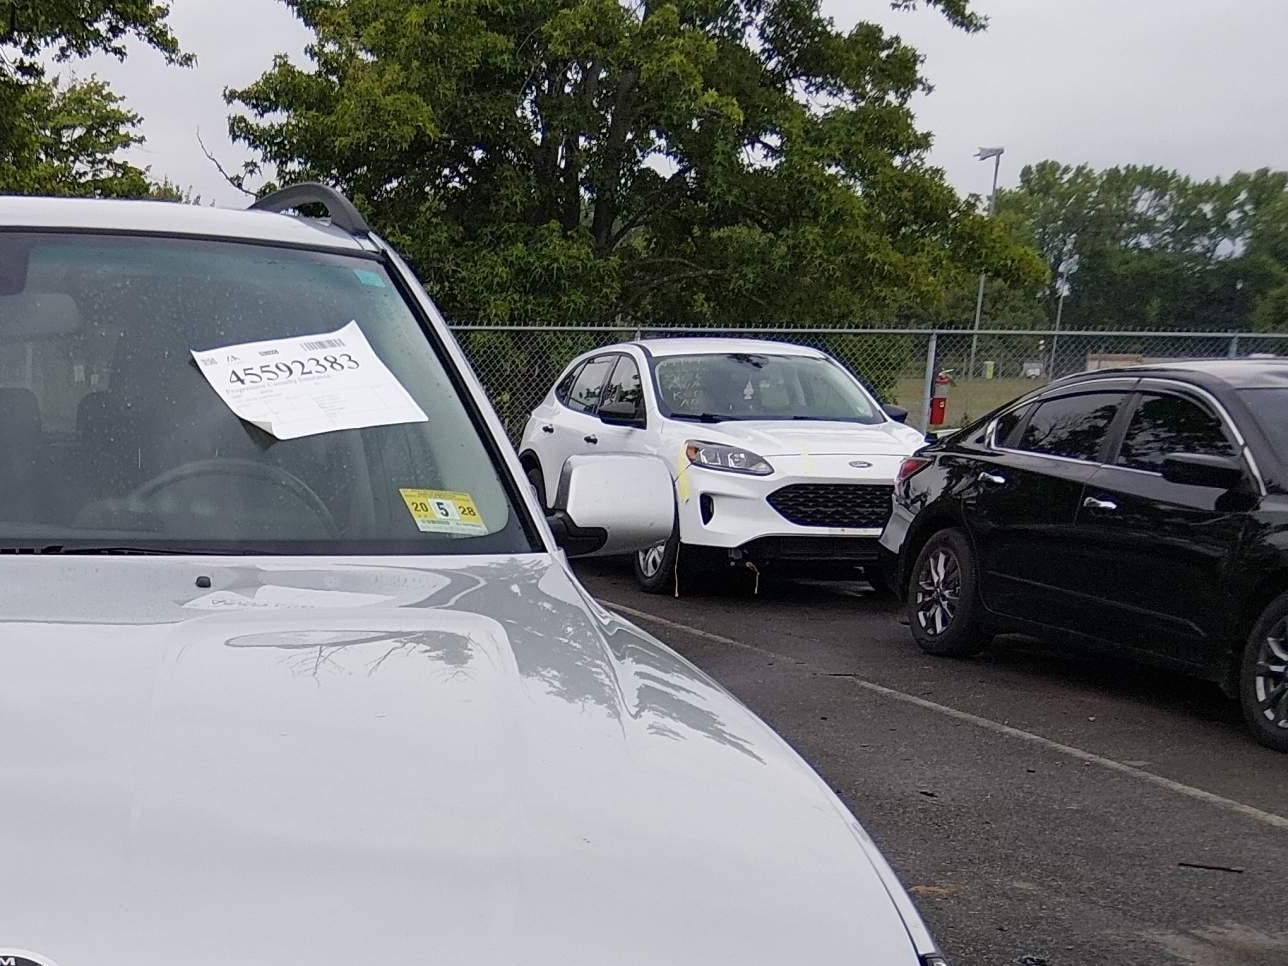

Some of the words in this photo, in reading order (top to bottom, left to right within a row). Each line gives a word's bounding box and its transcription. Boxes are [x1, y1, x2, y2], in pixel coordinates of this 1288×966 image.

[229, 353, 360, 386] 45592383
[411, 502, 429, 513] 20
[435, 501, 450, 518] 5
[458, 505, 477, 517] 28
